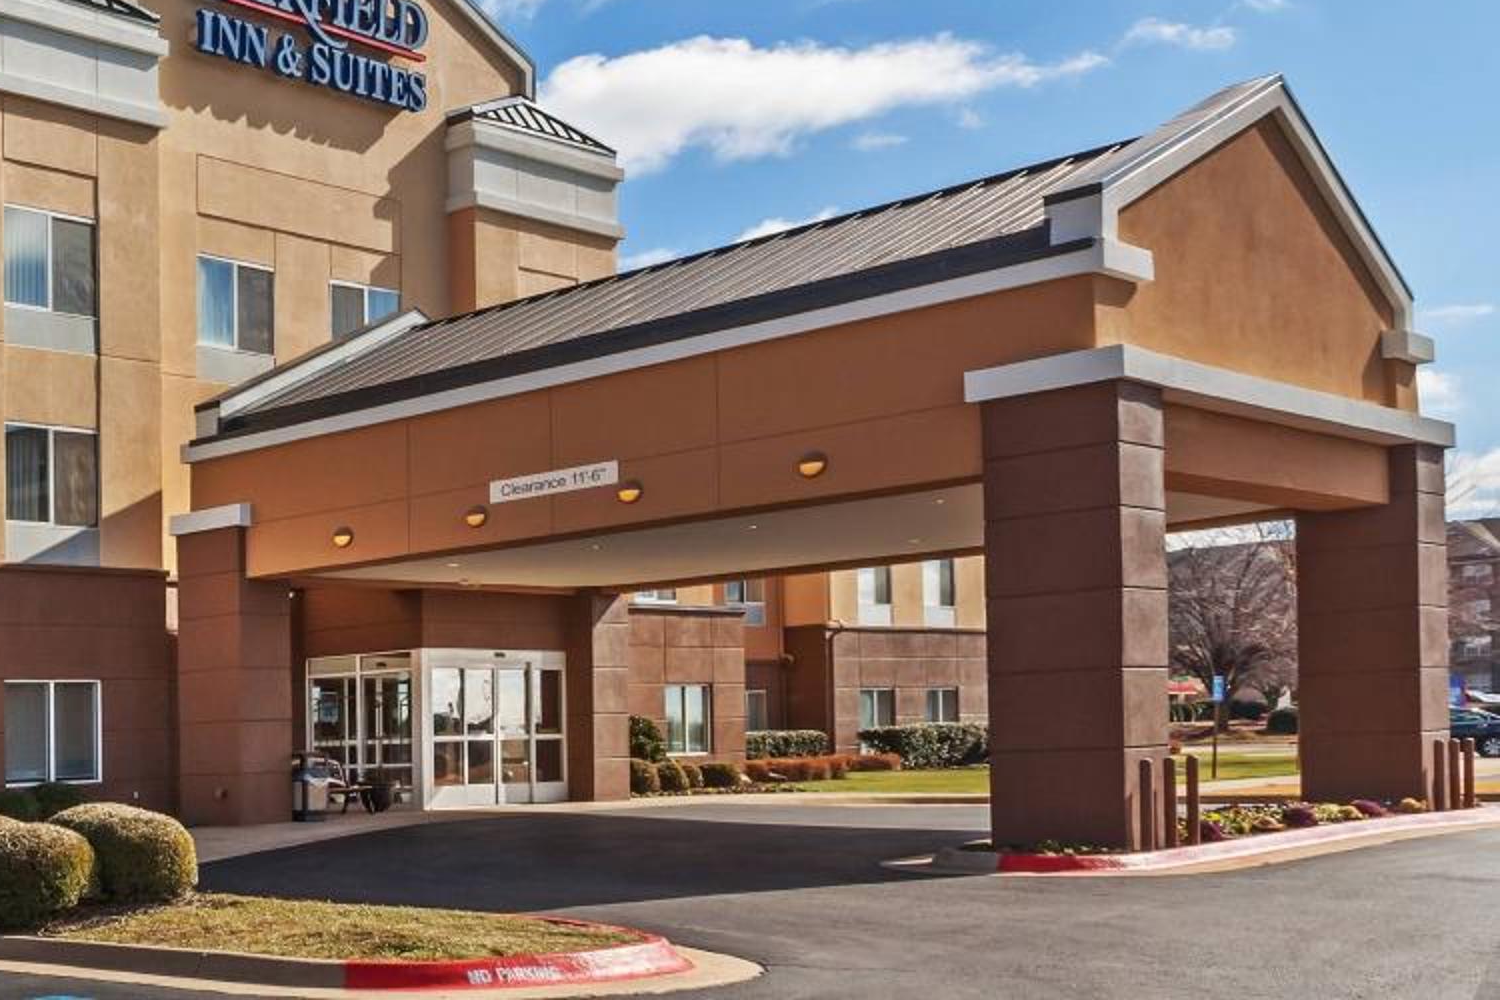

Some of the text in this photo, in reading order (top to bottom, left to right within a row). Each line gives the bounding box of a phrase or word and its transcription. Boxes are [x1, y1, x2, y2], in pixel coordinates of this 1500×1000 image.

[197, 9, 428, 112] INN & SUITES
[501, 477, 567, 497] Clearance
[467, 965, 563, 985] NO PARKING
